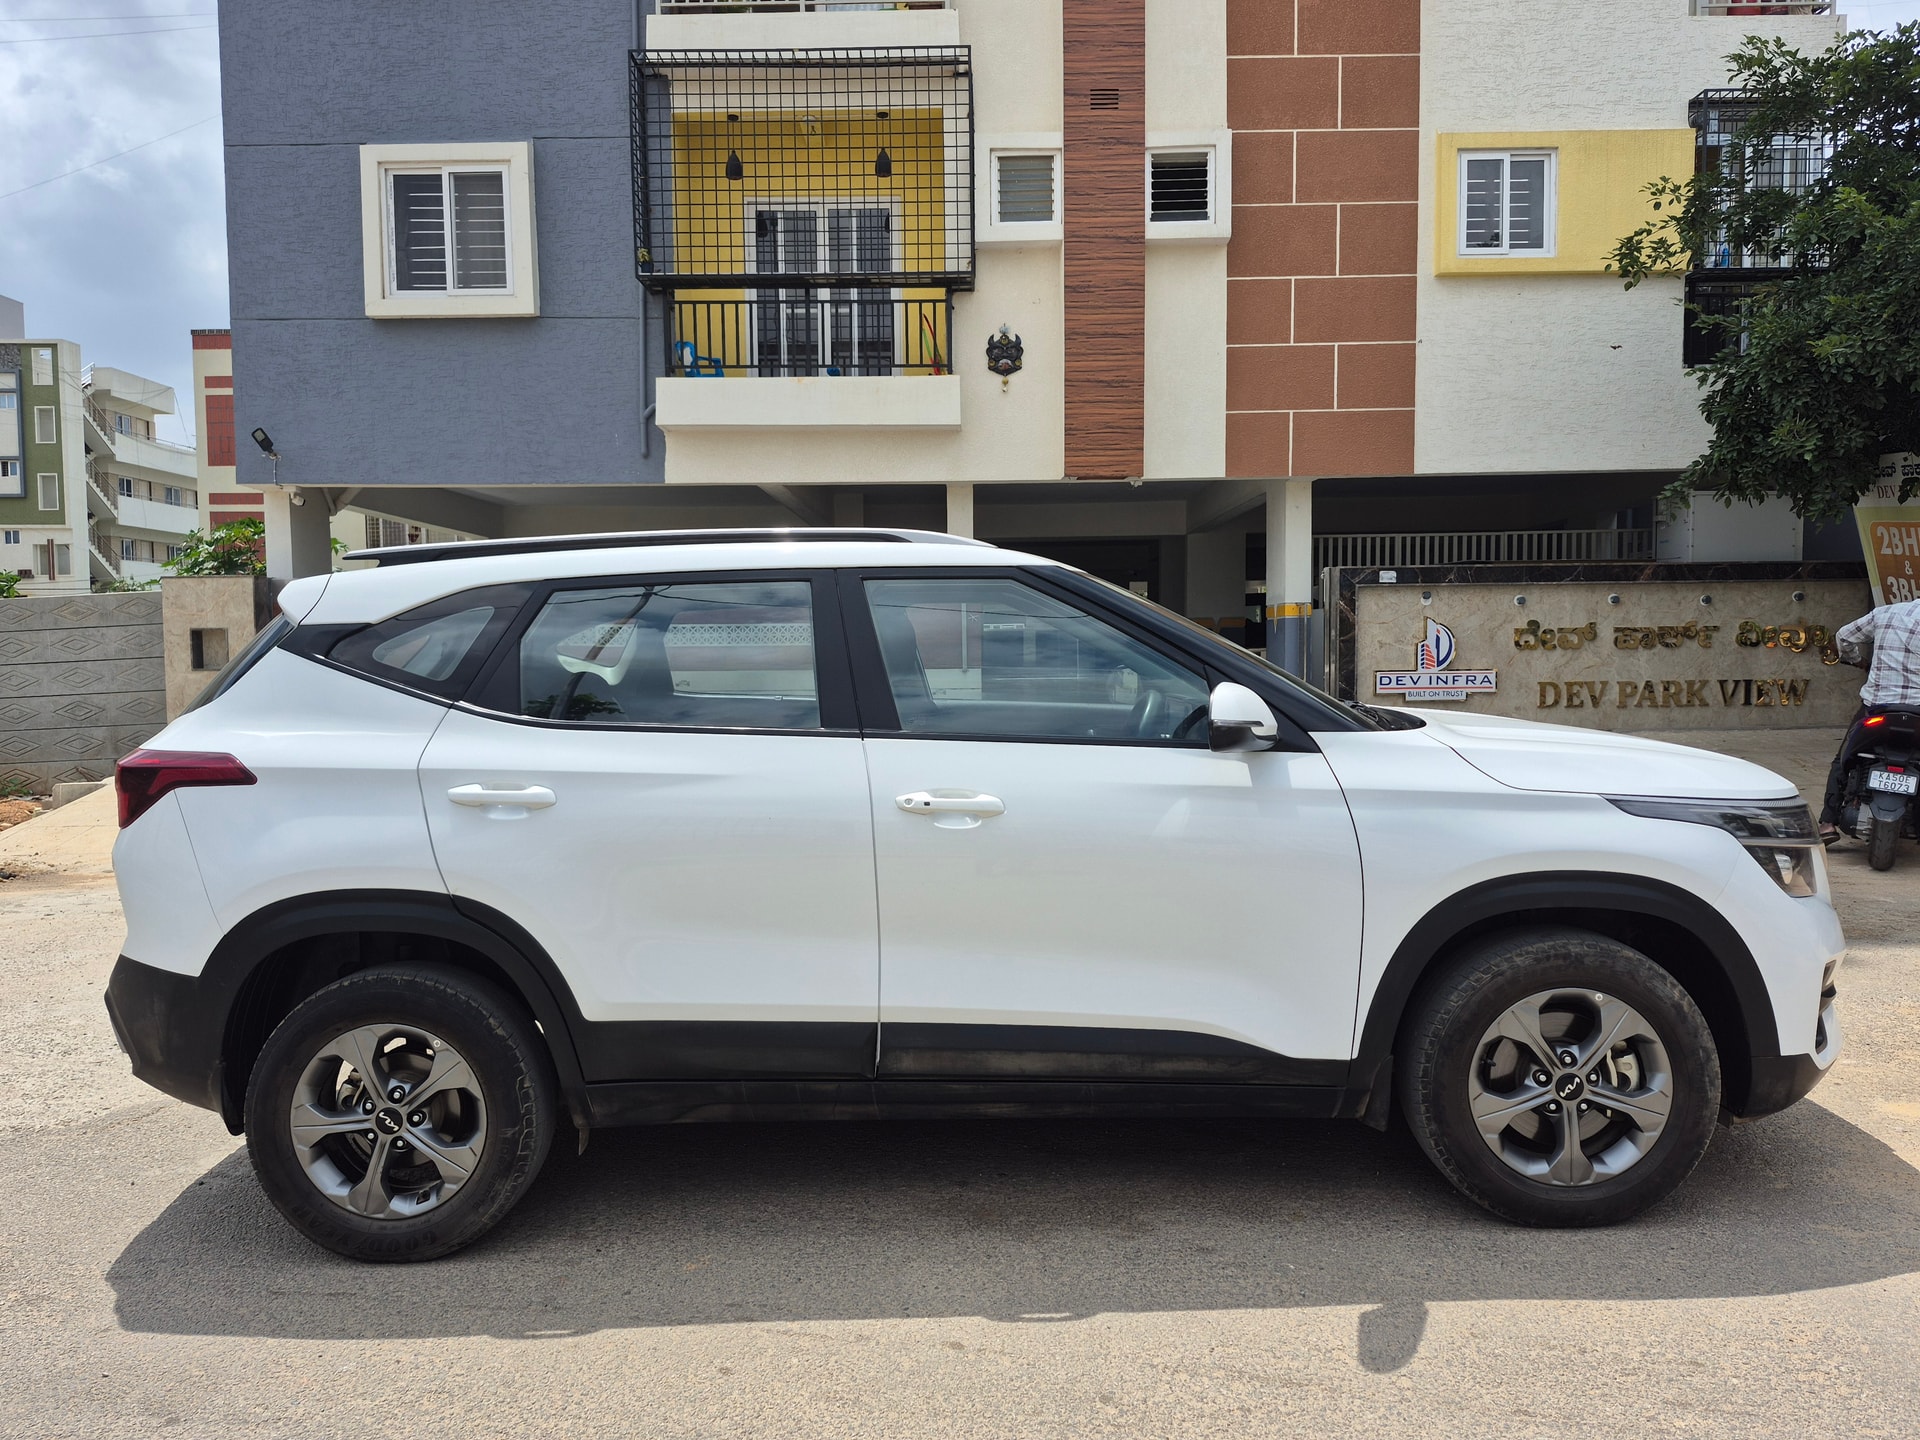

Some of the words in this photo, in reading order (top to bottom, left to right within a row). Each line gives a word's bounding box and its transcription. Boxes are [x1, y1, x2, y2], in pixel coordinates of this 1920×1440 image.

[1876, 485, 1896, 499] DEV
[1876, 525, 1920, 557] 2BH
[1904, 560, 1913, 575] &
[1379, 675, 1421, 686] DEV
[1429, 674, 1492, 686] INFRA
[1537, 680, 1609, 709] DEV
[1616, 680, 1709, 709] PARK
[1717, 678, 1811, 707] VIEW
